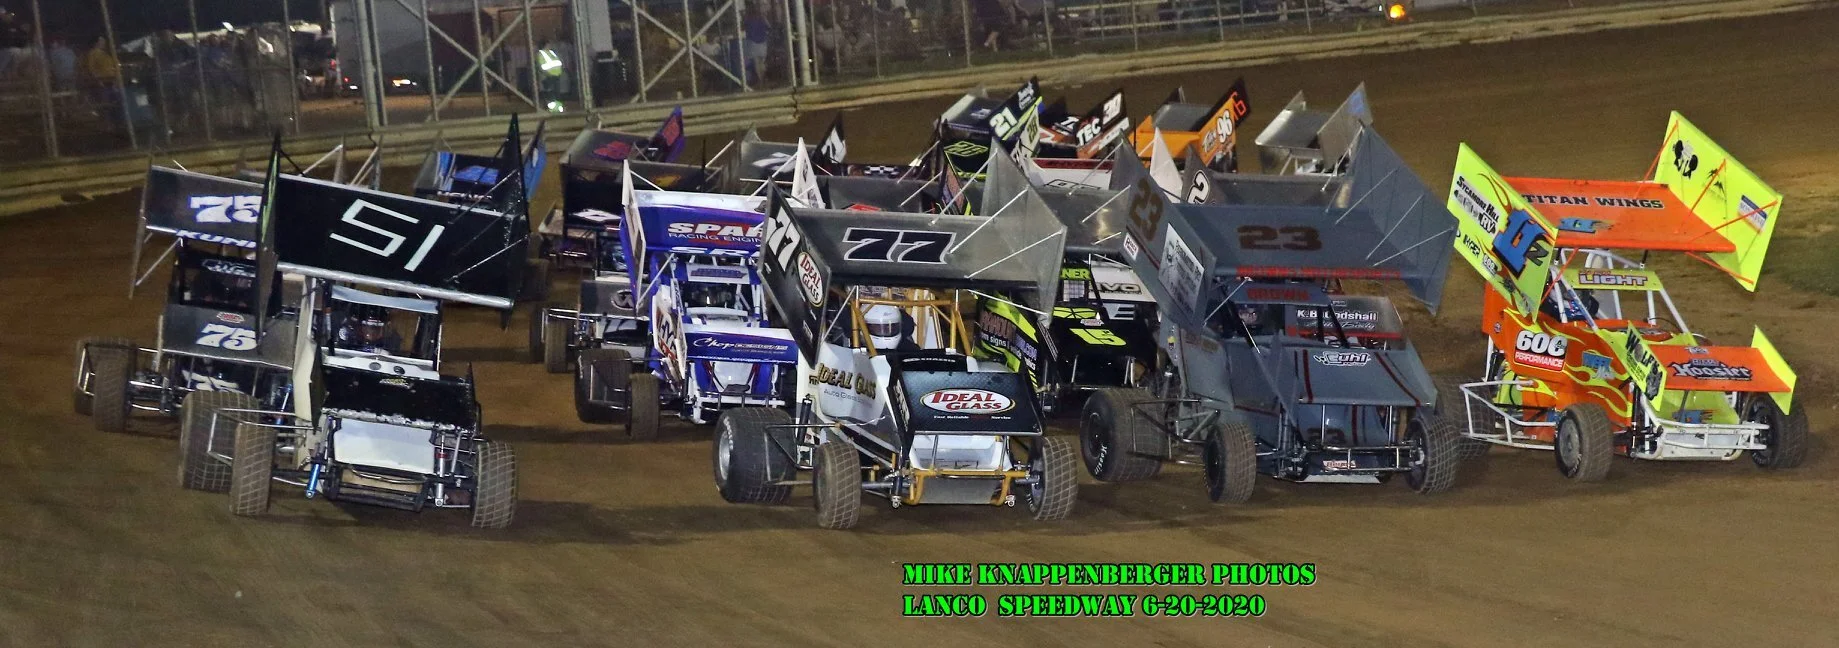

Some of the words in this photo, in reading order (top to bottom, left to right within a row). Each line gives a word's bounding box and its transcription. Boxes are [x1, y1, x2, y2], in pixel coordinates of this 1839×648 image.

[989, 107, 1018, 138] 21
[1076, 118, 1101, 147] TEC
[1217, 109, 1233, 143] 96
[187, 195, 263, 223] 75
[1485, 203, 1500, 223] HILL
[1522, 194, 1589, 205] TITAN
[1595, 197, 1665, 209] WINGS
[328, 198, 446, 272] 51
[1480, 212, 1496, 234] RV
[668, 232, 719, 240] RACING
[765, 205, 801, 273] 77
[841, 227, 957, 265] 77
[1236, 225, 1324, 250] 23
[799, 254, 822, 290] IDEAL
[1578, 273, 1649, 287] LIGHT
[801, 273, 821, 301] GLASS
[195, 322, 258, 351] 75
[989, 336, 1007, 347] signs
[1069, 328, 1127, 347] 15
[1514, 351, 1565, 369] PERFORMANCE
[1671, 362, 1753, 378] Hoosier
[818, 362, 854, 390] IDEAL
[930, 391, 997, 404] IDEAL
[945, 401, 1002, 411] GLASS
